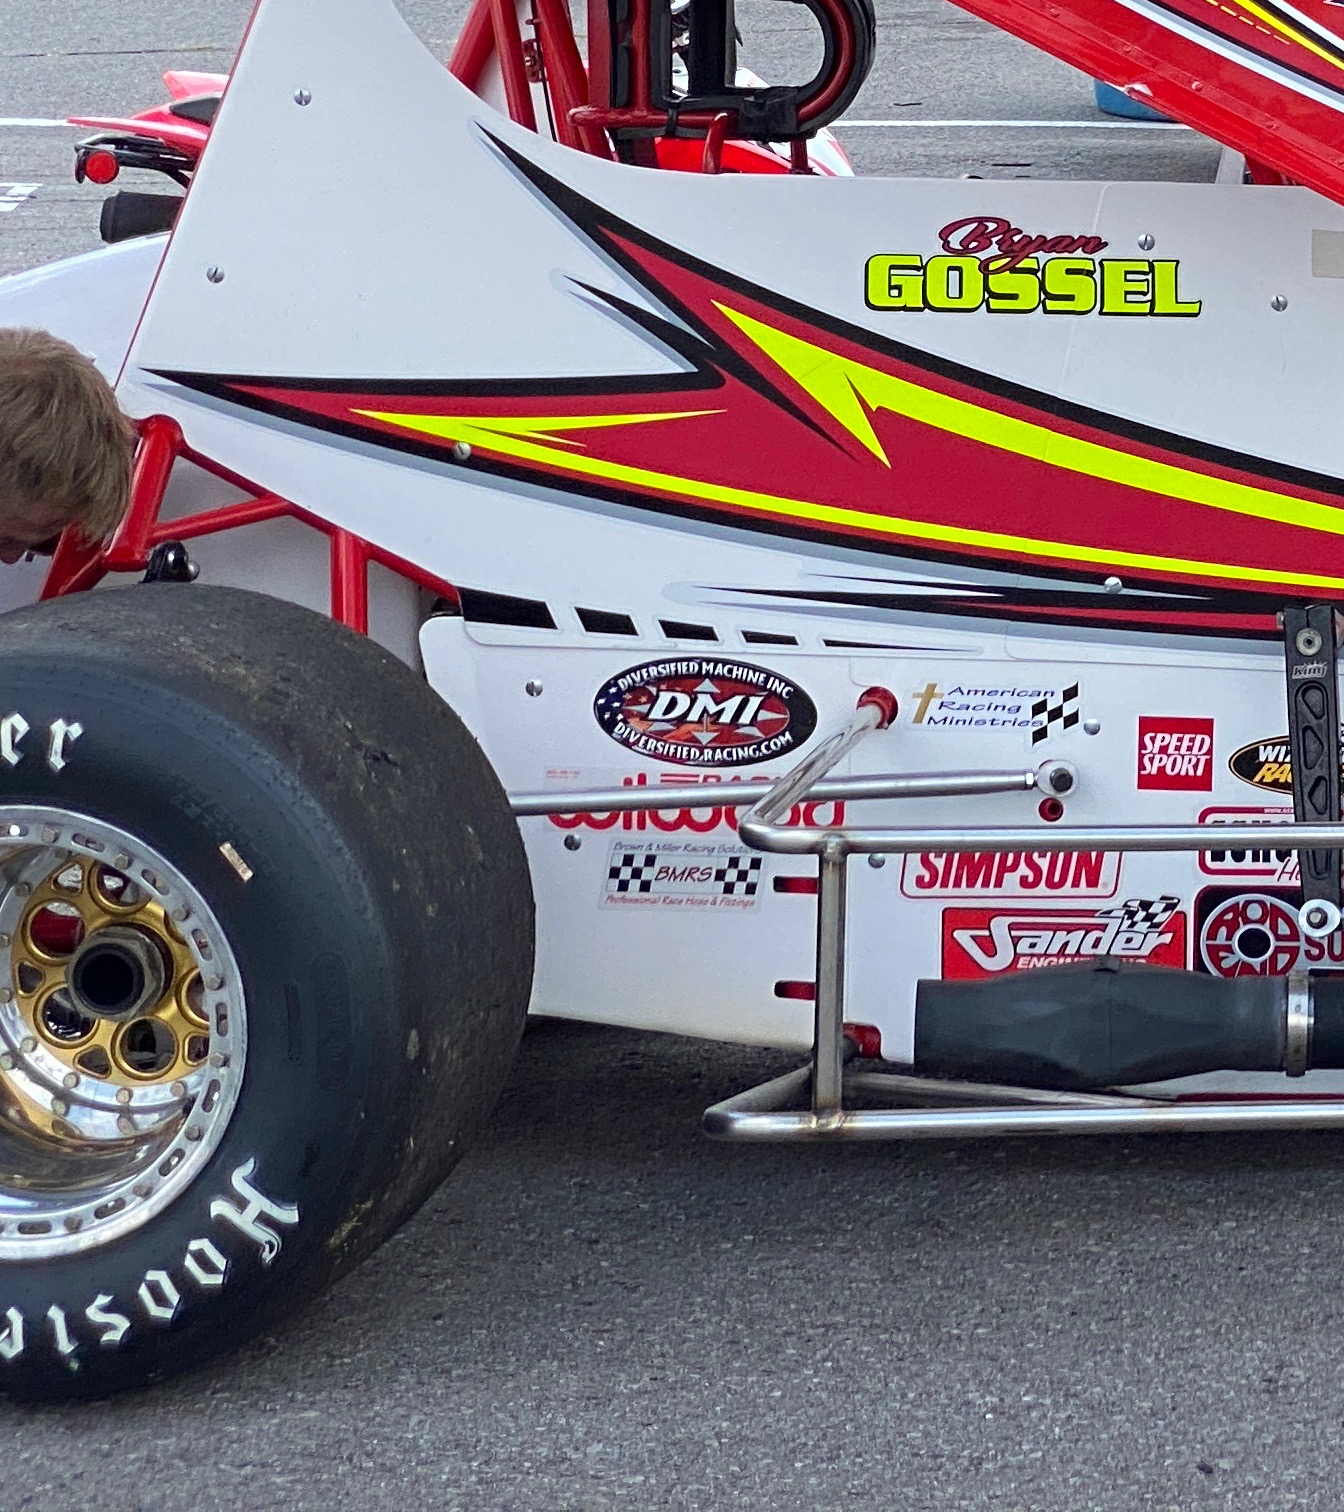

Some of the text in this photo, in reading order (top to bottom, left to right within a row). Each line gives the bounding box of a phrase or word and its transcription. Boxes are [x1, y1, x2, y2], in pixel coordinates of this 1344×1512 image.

[938, 216, 1109, 274] Bryan
[865, 254, 1201, 317] GOSSEL
[617, 661, 794, 700] DIVERSIFIED MACHINE INC
[947, 686, 1055, 699] American
[647, 690, 765, 725] DMI
[938, 700, 1022, 714] Racing
[926, 715, 1044, 728] Ministries
[1140, 732, 1211, 756] SPEED
[1140, 753, 1211, 777] SPORT
[613, 842, 644, 852] Brown
[683, 843, 715, 854] Racing
[654, 865, 713, 883] BMRS
[914, 851, 1104, 890] SIMPSON
[661, 896, 684, 905] Race
[953, 916, 1175, 972] Sander
